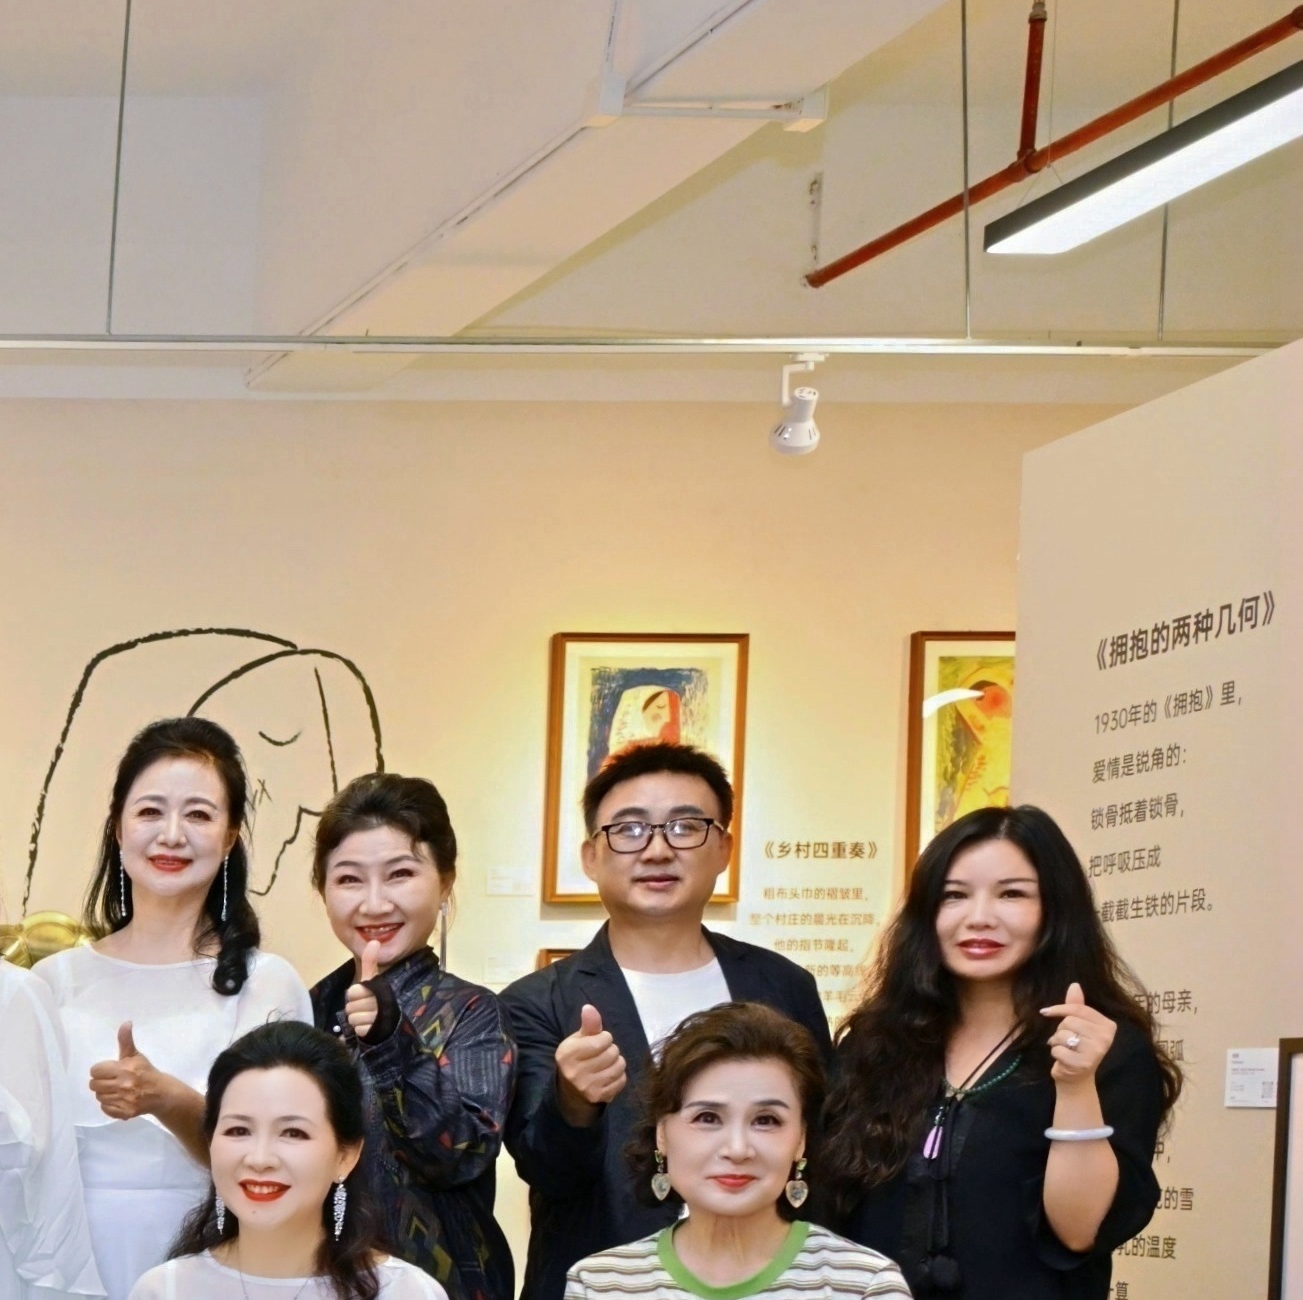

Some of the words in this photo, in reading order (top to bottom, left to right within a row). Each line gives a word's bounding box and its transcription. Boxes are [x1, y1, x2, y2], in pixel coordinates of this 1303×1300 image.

[1096, 590, 1275, 671] 《拥抱的两种几何》
[764, 841, 878, 860] 《乡村四重奏》
[1088, 845, 1161, 879] 把呼吸压成
[1155, 1186, 1194, 1211] 的雪
